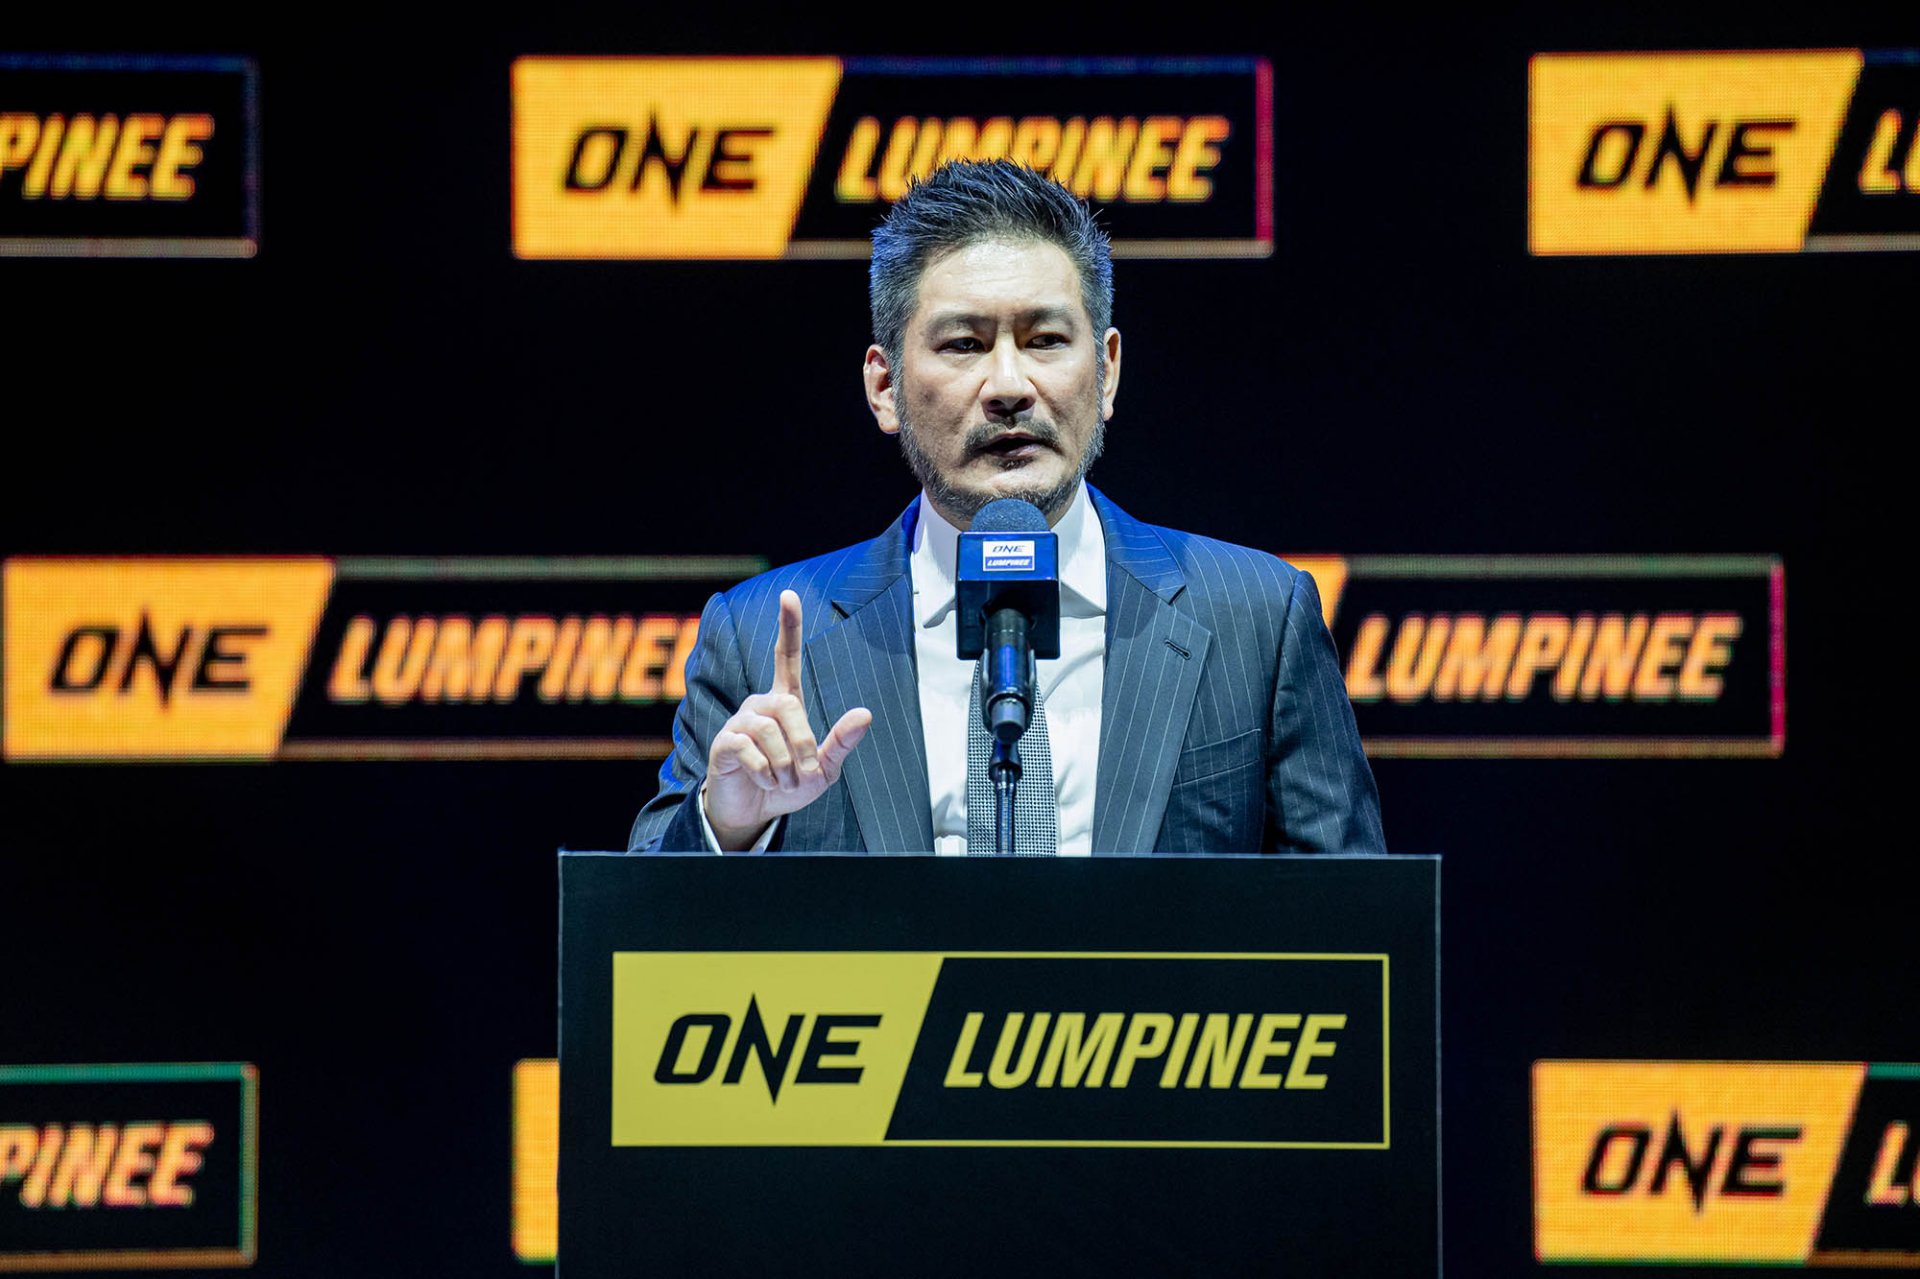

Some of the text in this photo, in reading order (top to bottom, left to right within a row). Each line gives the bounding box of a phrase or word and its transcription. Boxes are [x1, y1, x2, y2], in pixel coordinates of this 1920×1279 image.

[564, 104, 775, 212] ONE
[1575, 100, 1797, 208] ONE
[992, 544, 1026, 553] ONE
[49, 606, 268, 711] ONE
[1345, 612, 1743, 702] LUMPINEE
[653, 993, 1348, 1106] ONE LUMPINEE
[1580, 1107, 1804, 1216] ONE
